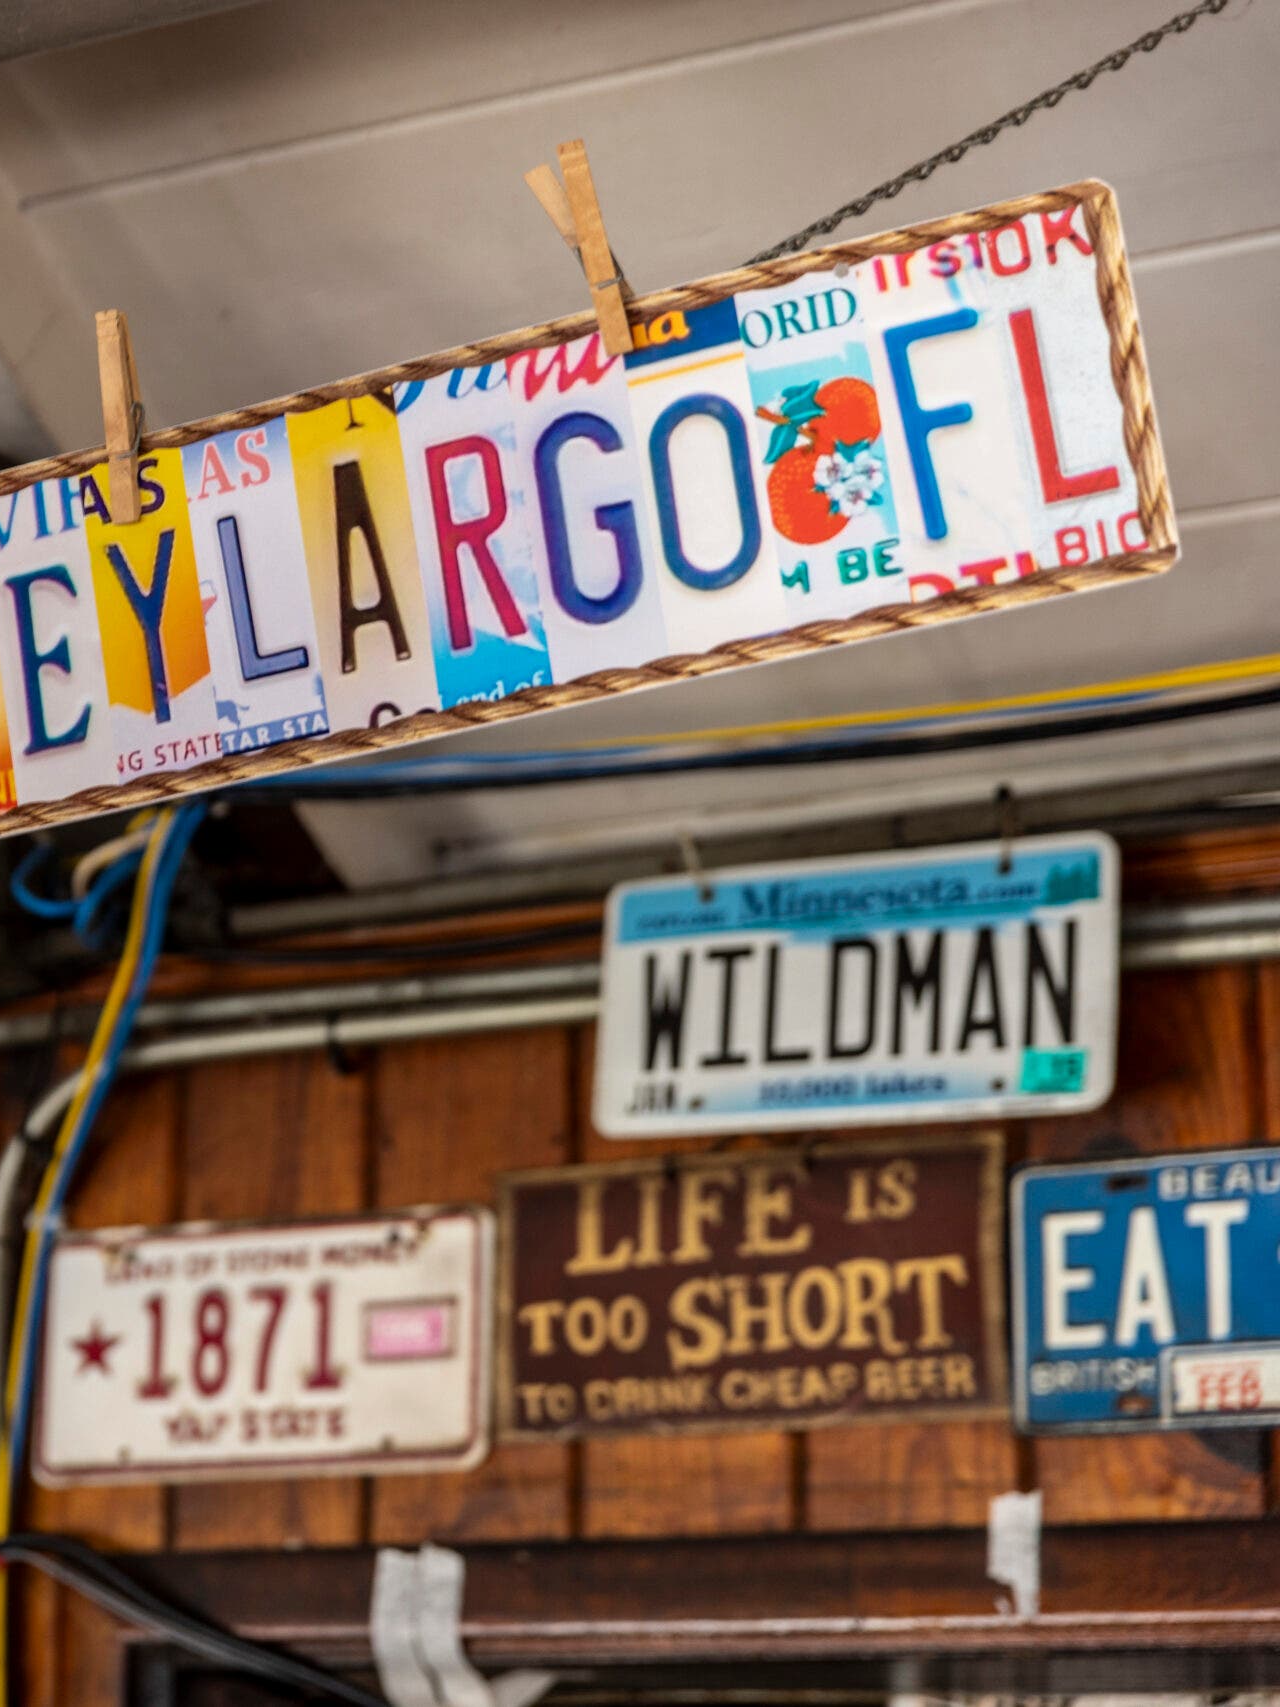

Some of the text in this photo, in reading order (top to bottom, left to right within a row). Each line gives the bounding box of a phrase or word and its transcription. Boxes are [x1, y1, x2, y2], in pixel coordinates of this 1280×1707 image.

[883, 307, 1122, 541] FL
[642, 916, 1078, 1073] WILDMAN
[565, 1158, 917, 1276] LIFE IS
[1040, 1197, 1251, 1352] EAT
[137, 1278, 345, 1402] 1871
[518, 1253, 969, 1372] TOO SHORT
